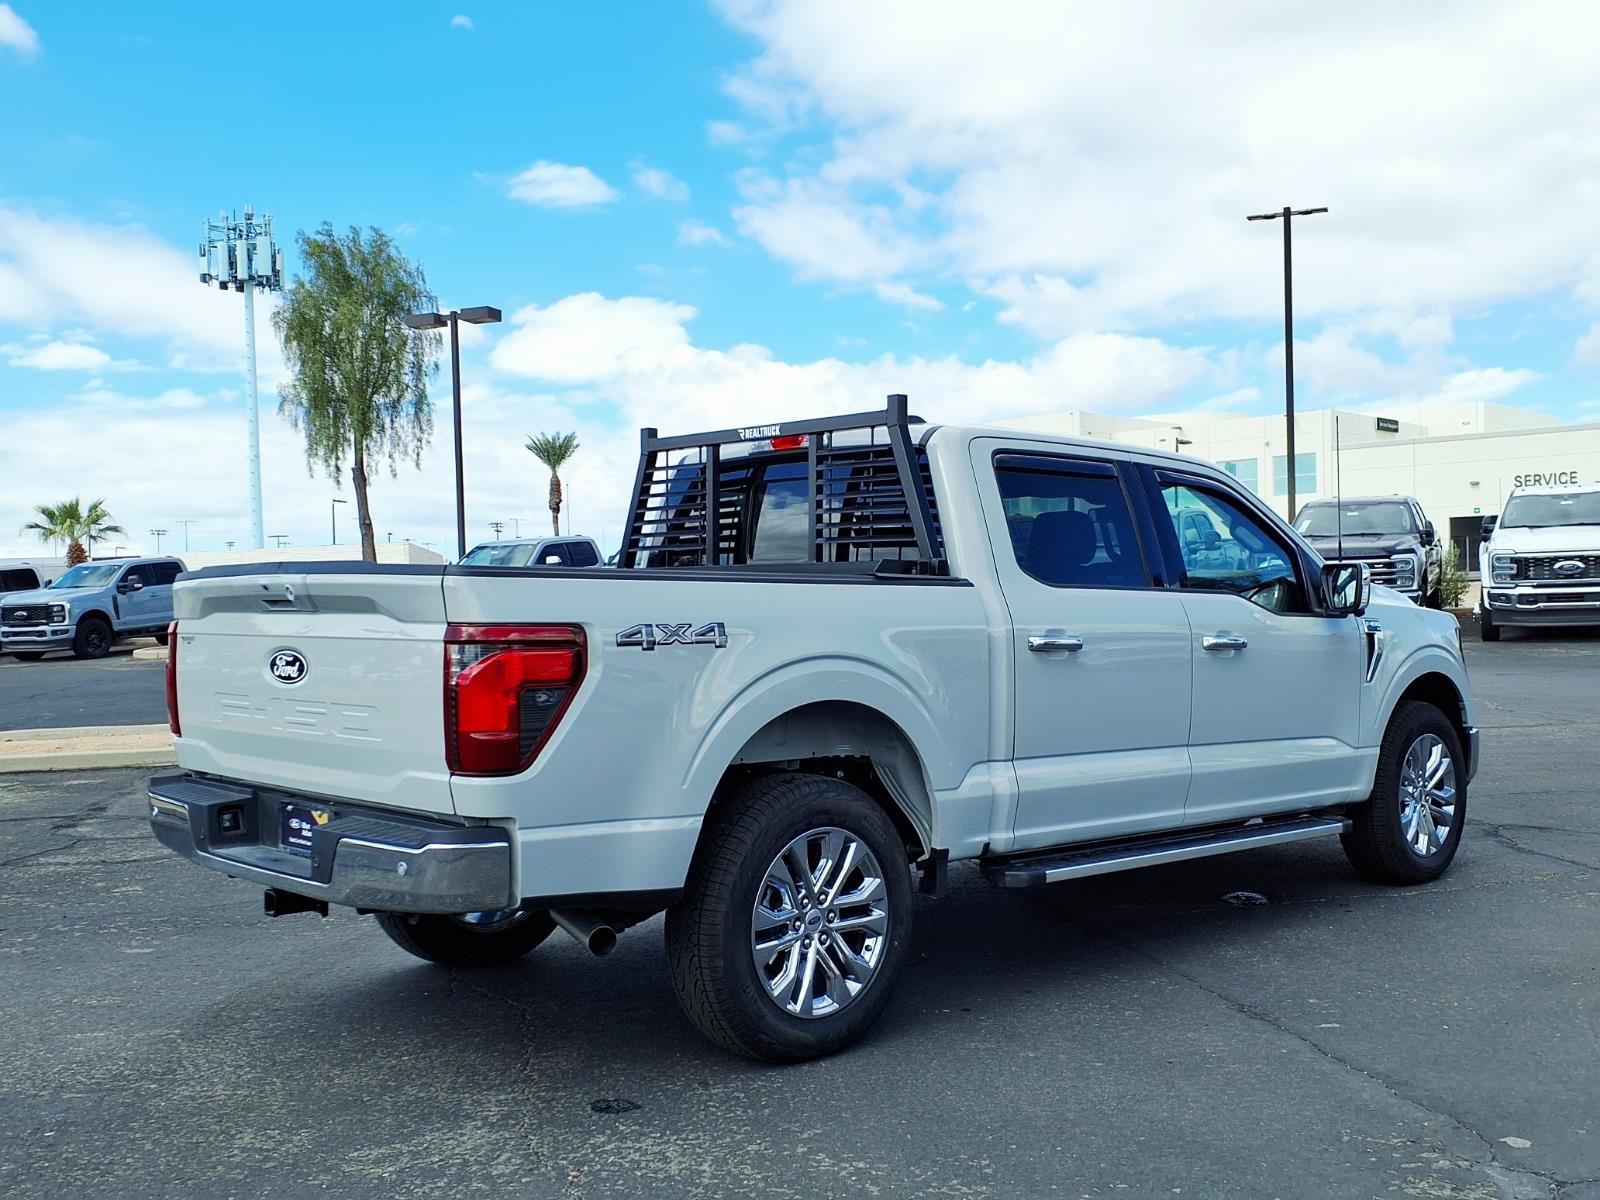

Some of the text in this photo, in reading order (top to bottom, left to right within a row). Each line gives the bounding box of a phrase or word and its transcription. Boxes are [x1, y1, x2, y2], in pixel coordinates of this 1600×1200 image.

[745, 425, 781, 439] REALTRUCK
[1513, 471, 1579, 488] SERVICE
[273, 654, 300, 678] Ford
[212, 691, 384, 742] F-150
